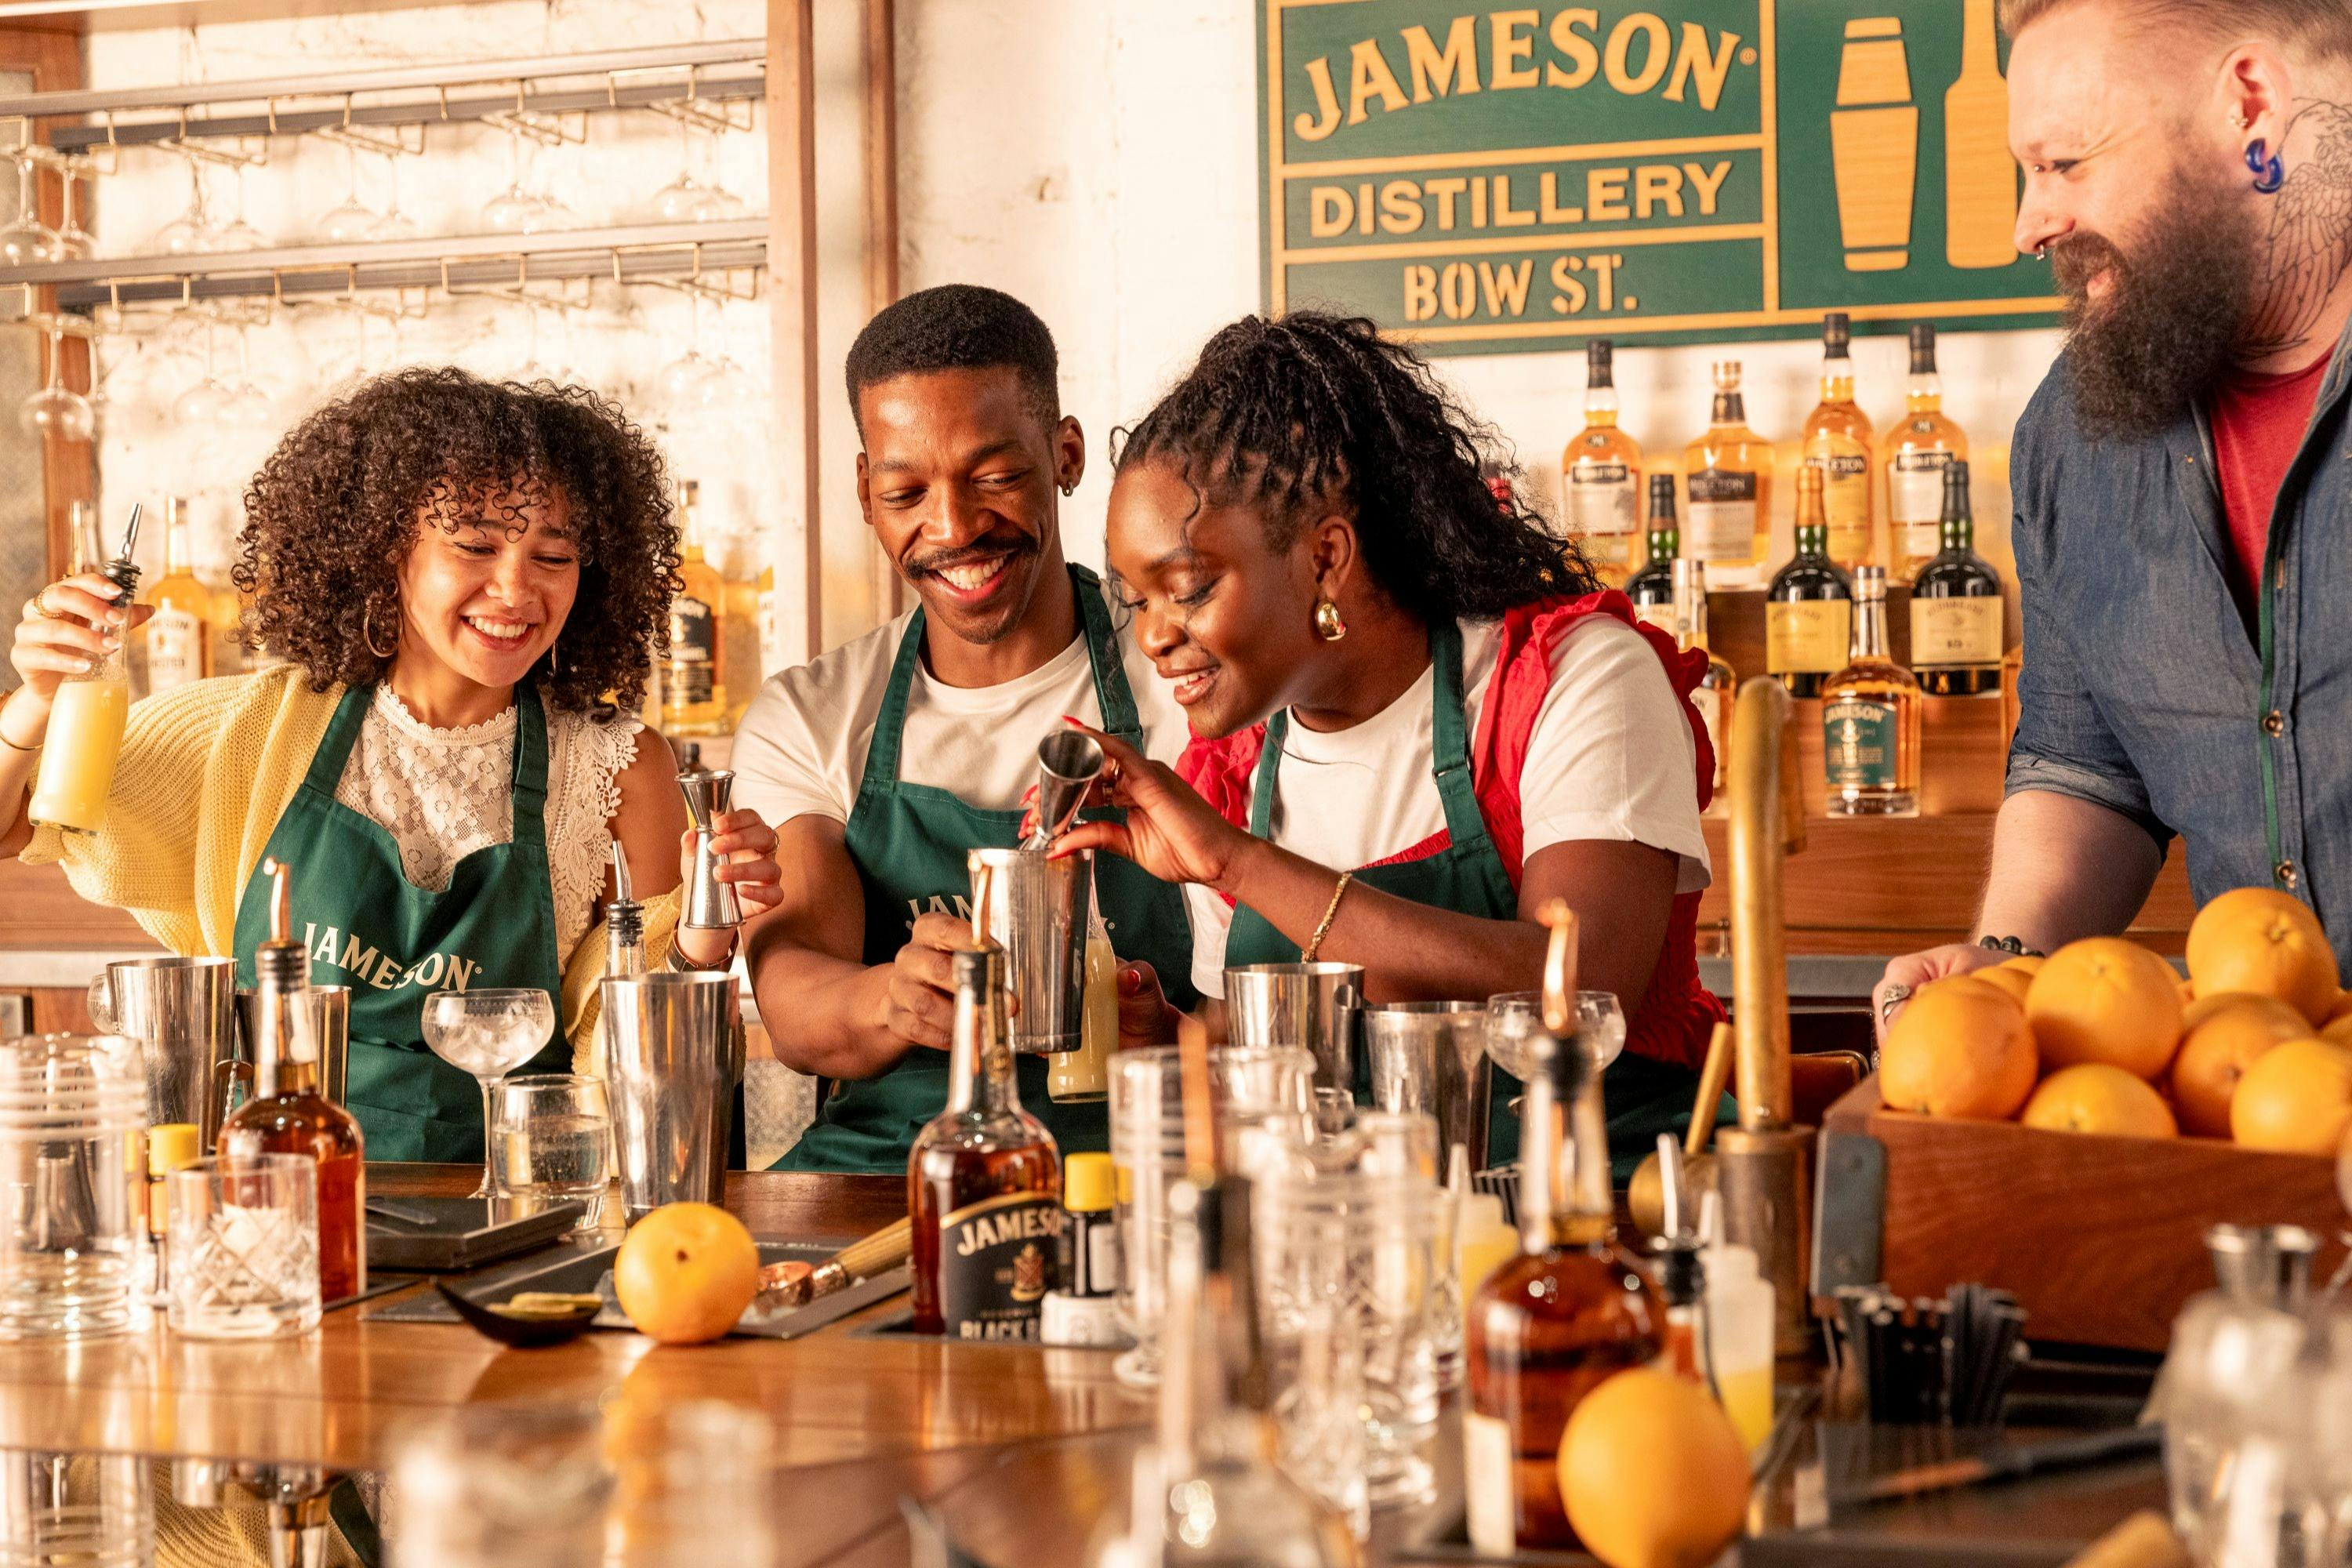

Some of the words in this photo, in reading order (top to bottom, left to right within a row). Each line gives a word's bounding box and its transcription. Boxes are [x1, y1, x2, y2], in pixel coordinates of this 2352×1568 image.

[1310, 161, 1733, 238] DISTILLERY
[1403, 260, 1534, 321] BOW
[1550, 254, 1639, 314] ST.
